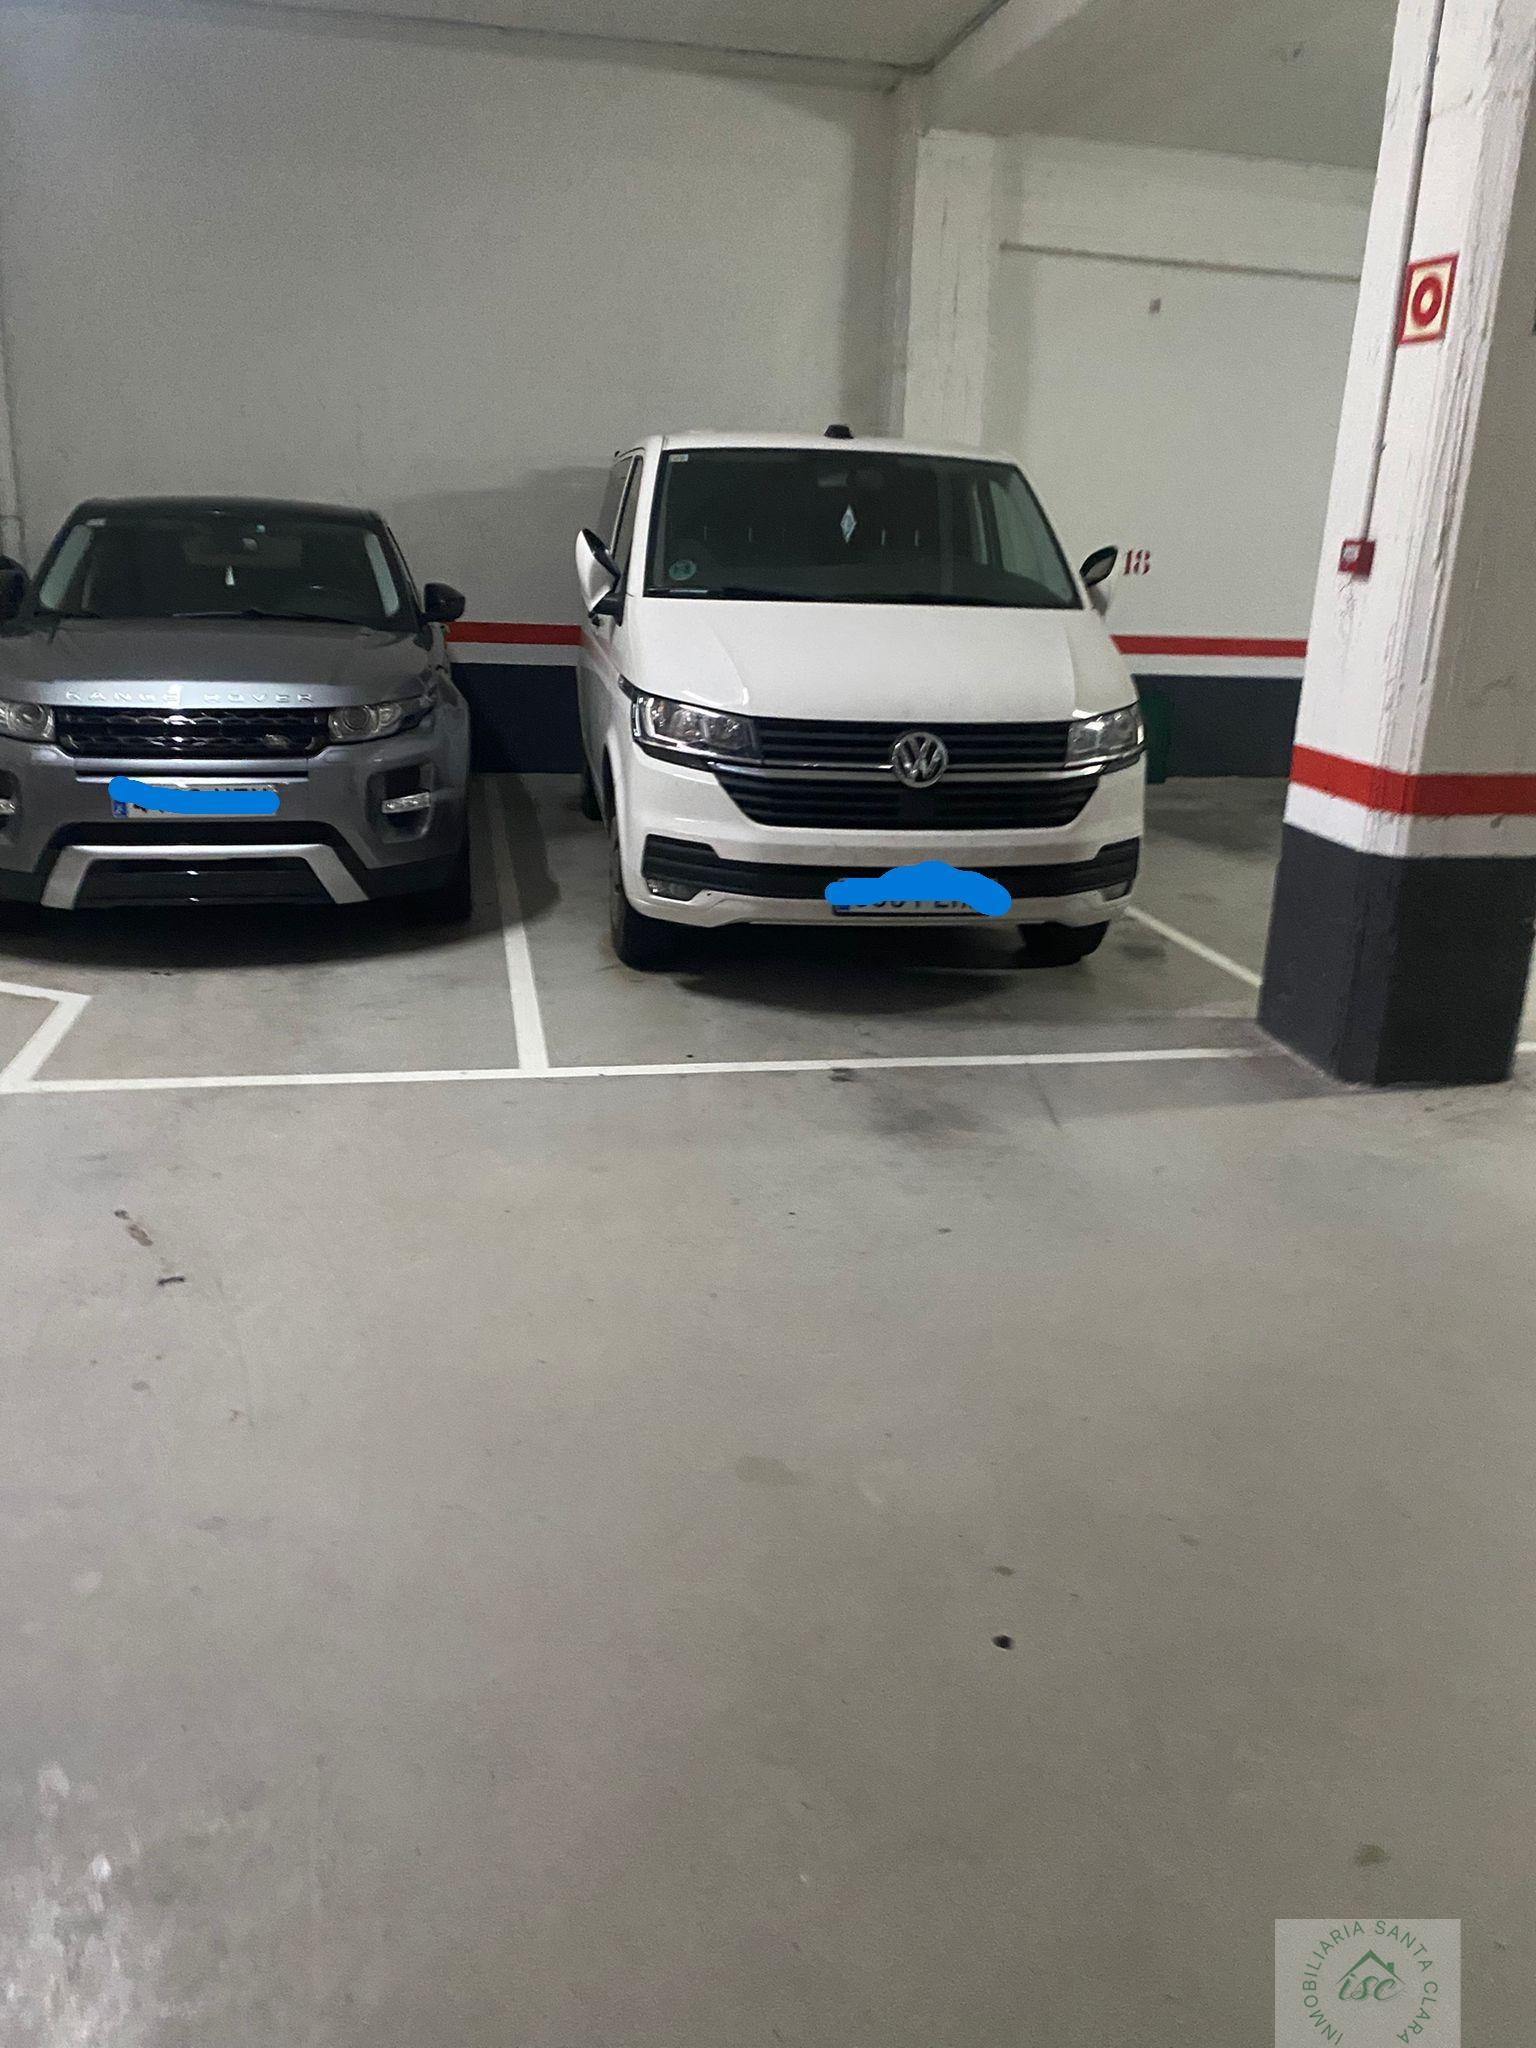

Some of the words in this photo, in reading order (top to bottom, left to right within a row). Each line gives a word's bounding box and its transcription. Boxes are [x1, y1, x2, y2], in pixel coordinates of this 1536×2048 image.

[1123, 549, 1151, 575] 18
[65, 690, 182, 703] RANGE
[203, 692, 316, 703] ROVER
